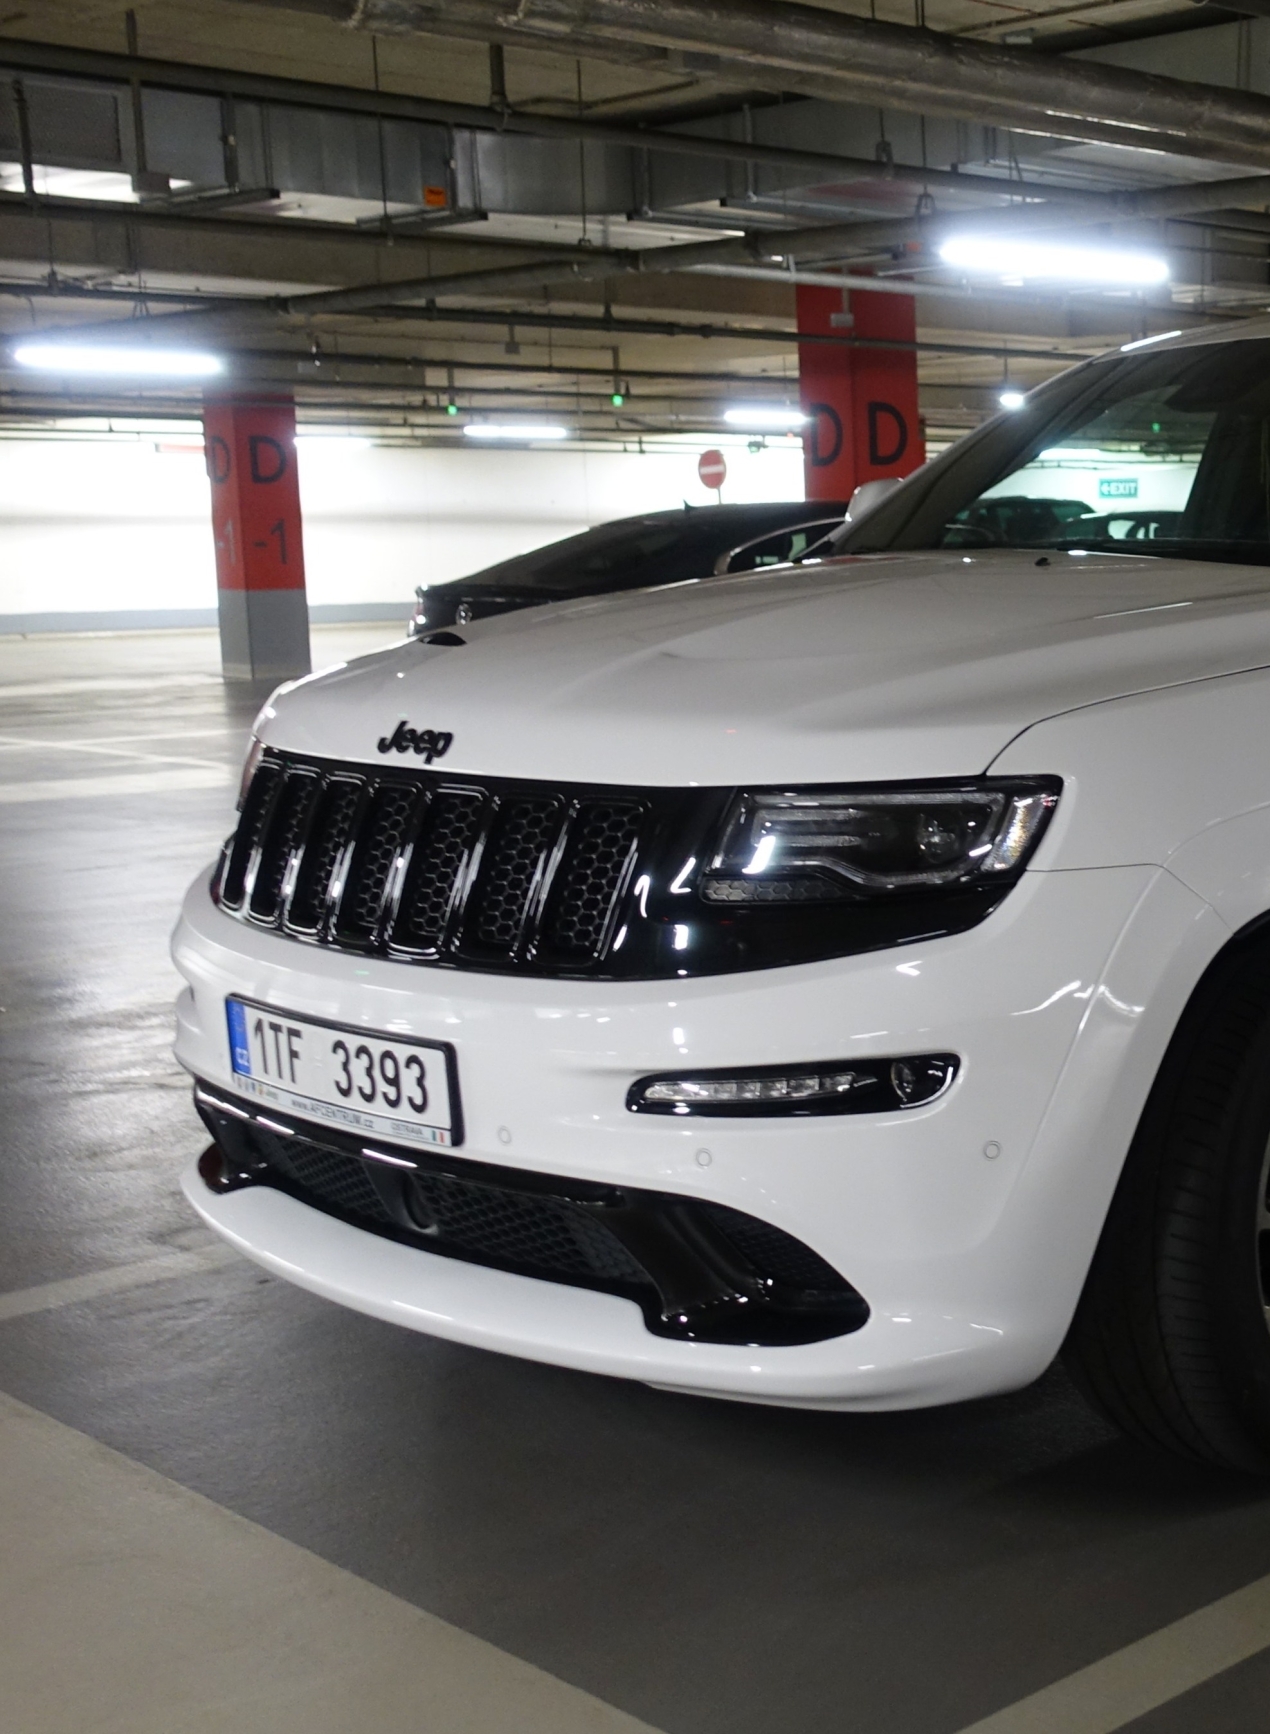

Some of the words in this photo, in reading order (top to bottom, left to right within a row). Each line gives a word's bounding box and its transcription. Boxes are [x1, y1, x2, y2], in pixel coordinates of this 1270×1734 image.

[810, 402, 843, 467] D
[868, 401, 908, 466] D
[209, 435, 231, 483] D
[248, 434, 287, 484] D
[1110, 482, 1137, 495] EXIT
[253, 518, 287, 565] -1
[377, 720, 454, 765] Jeep
[254, 1018, 303, 1084] 1TF
[332, 1039, 428, 1114] 3393
